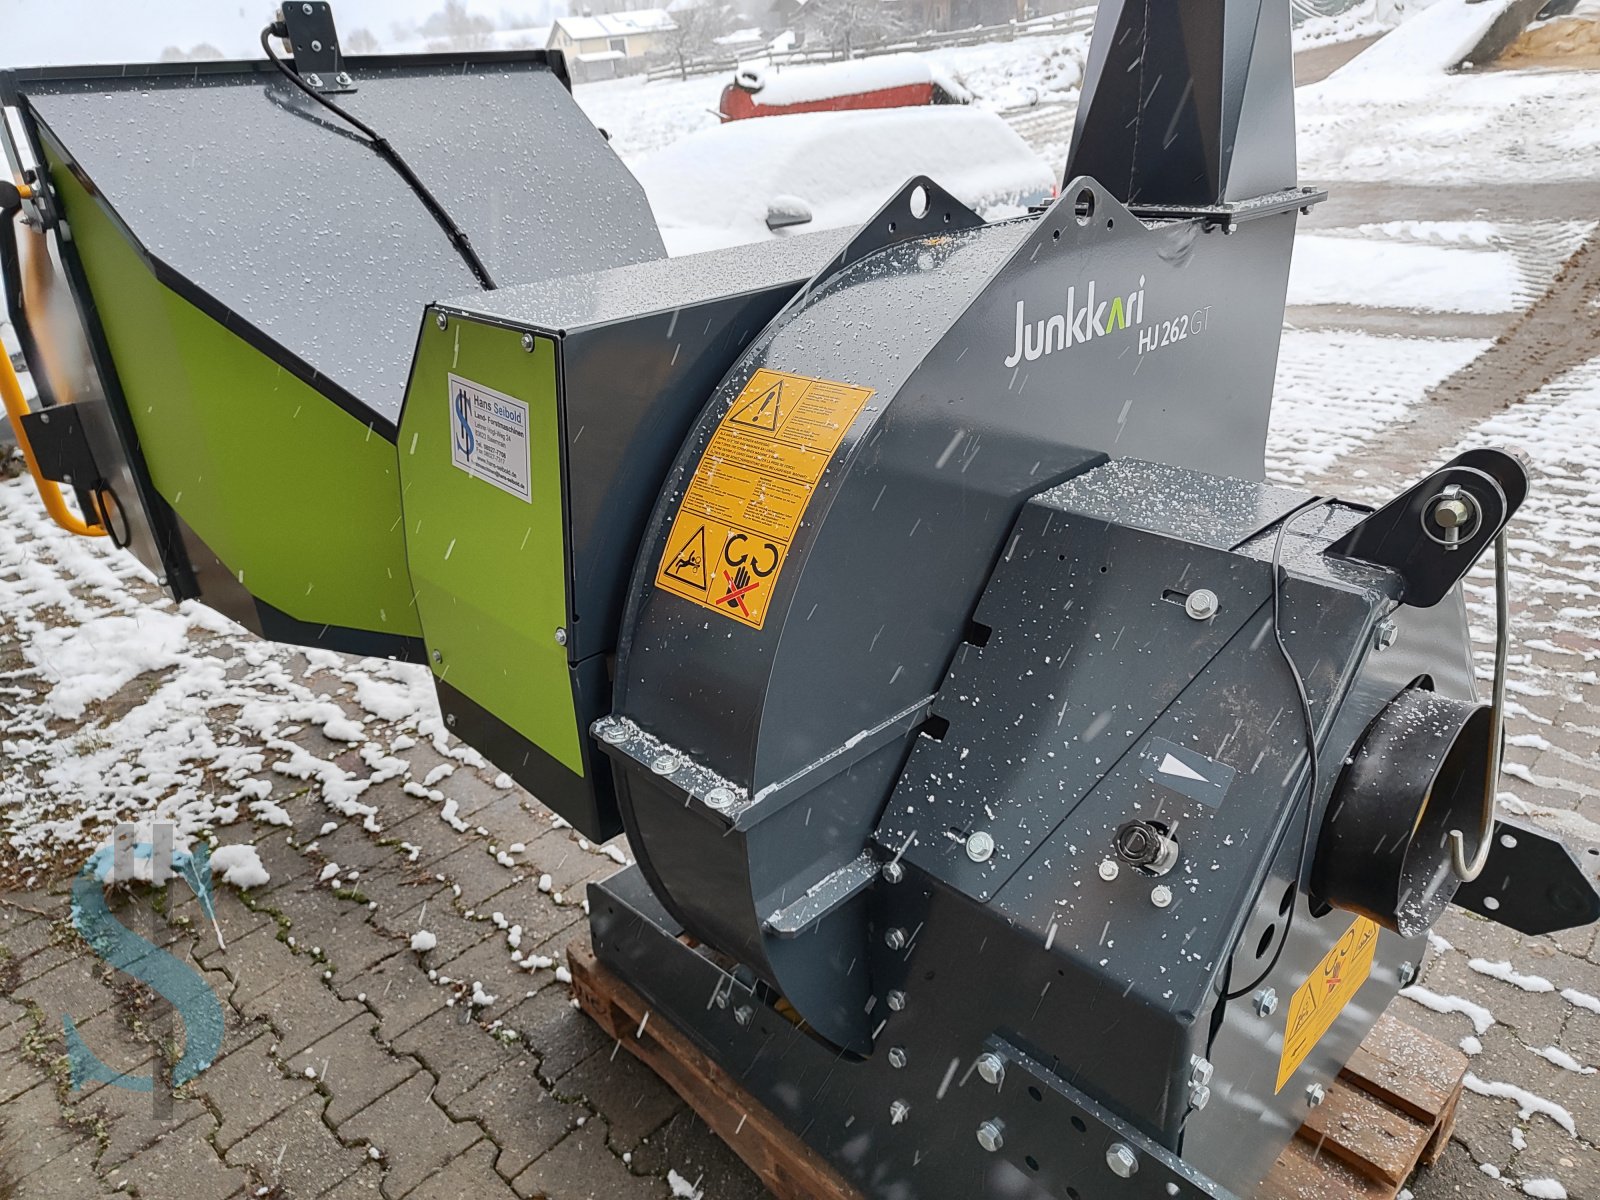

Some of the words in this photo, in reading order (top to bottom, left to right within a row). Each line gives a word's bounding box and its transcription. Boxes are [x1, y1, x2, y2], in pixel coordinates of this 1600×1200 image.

[1004, 274, 1146, 368] Junkkari
[1138, 324, 1159, 355] HJ
[473, 393, 491, 411] Hans
[493, 402, 521, 423] Seibold
